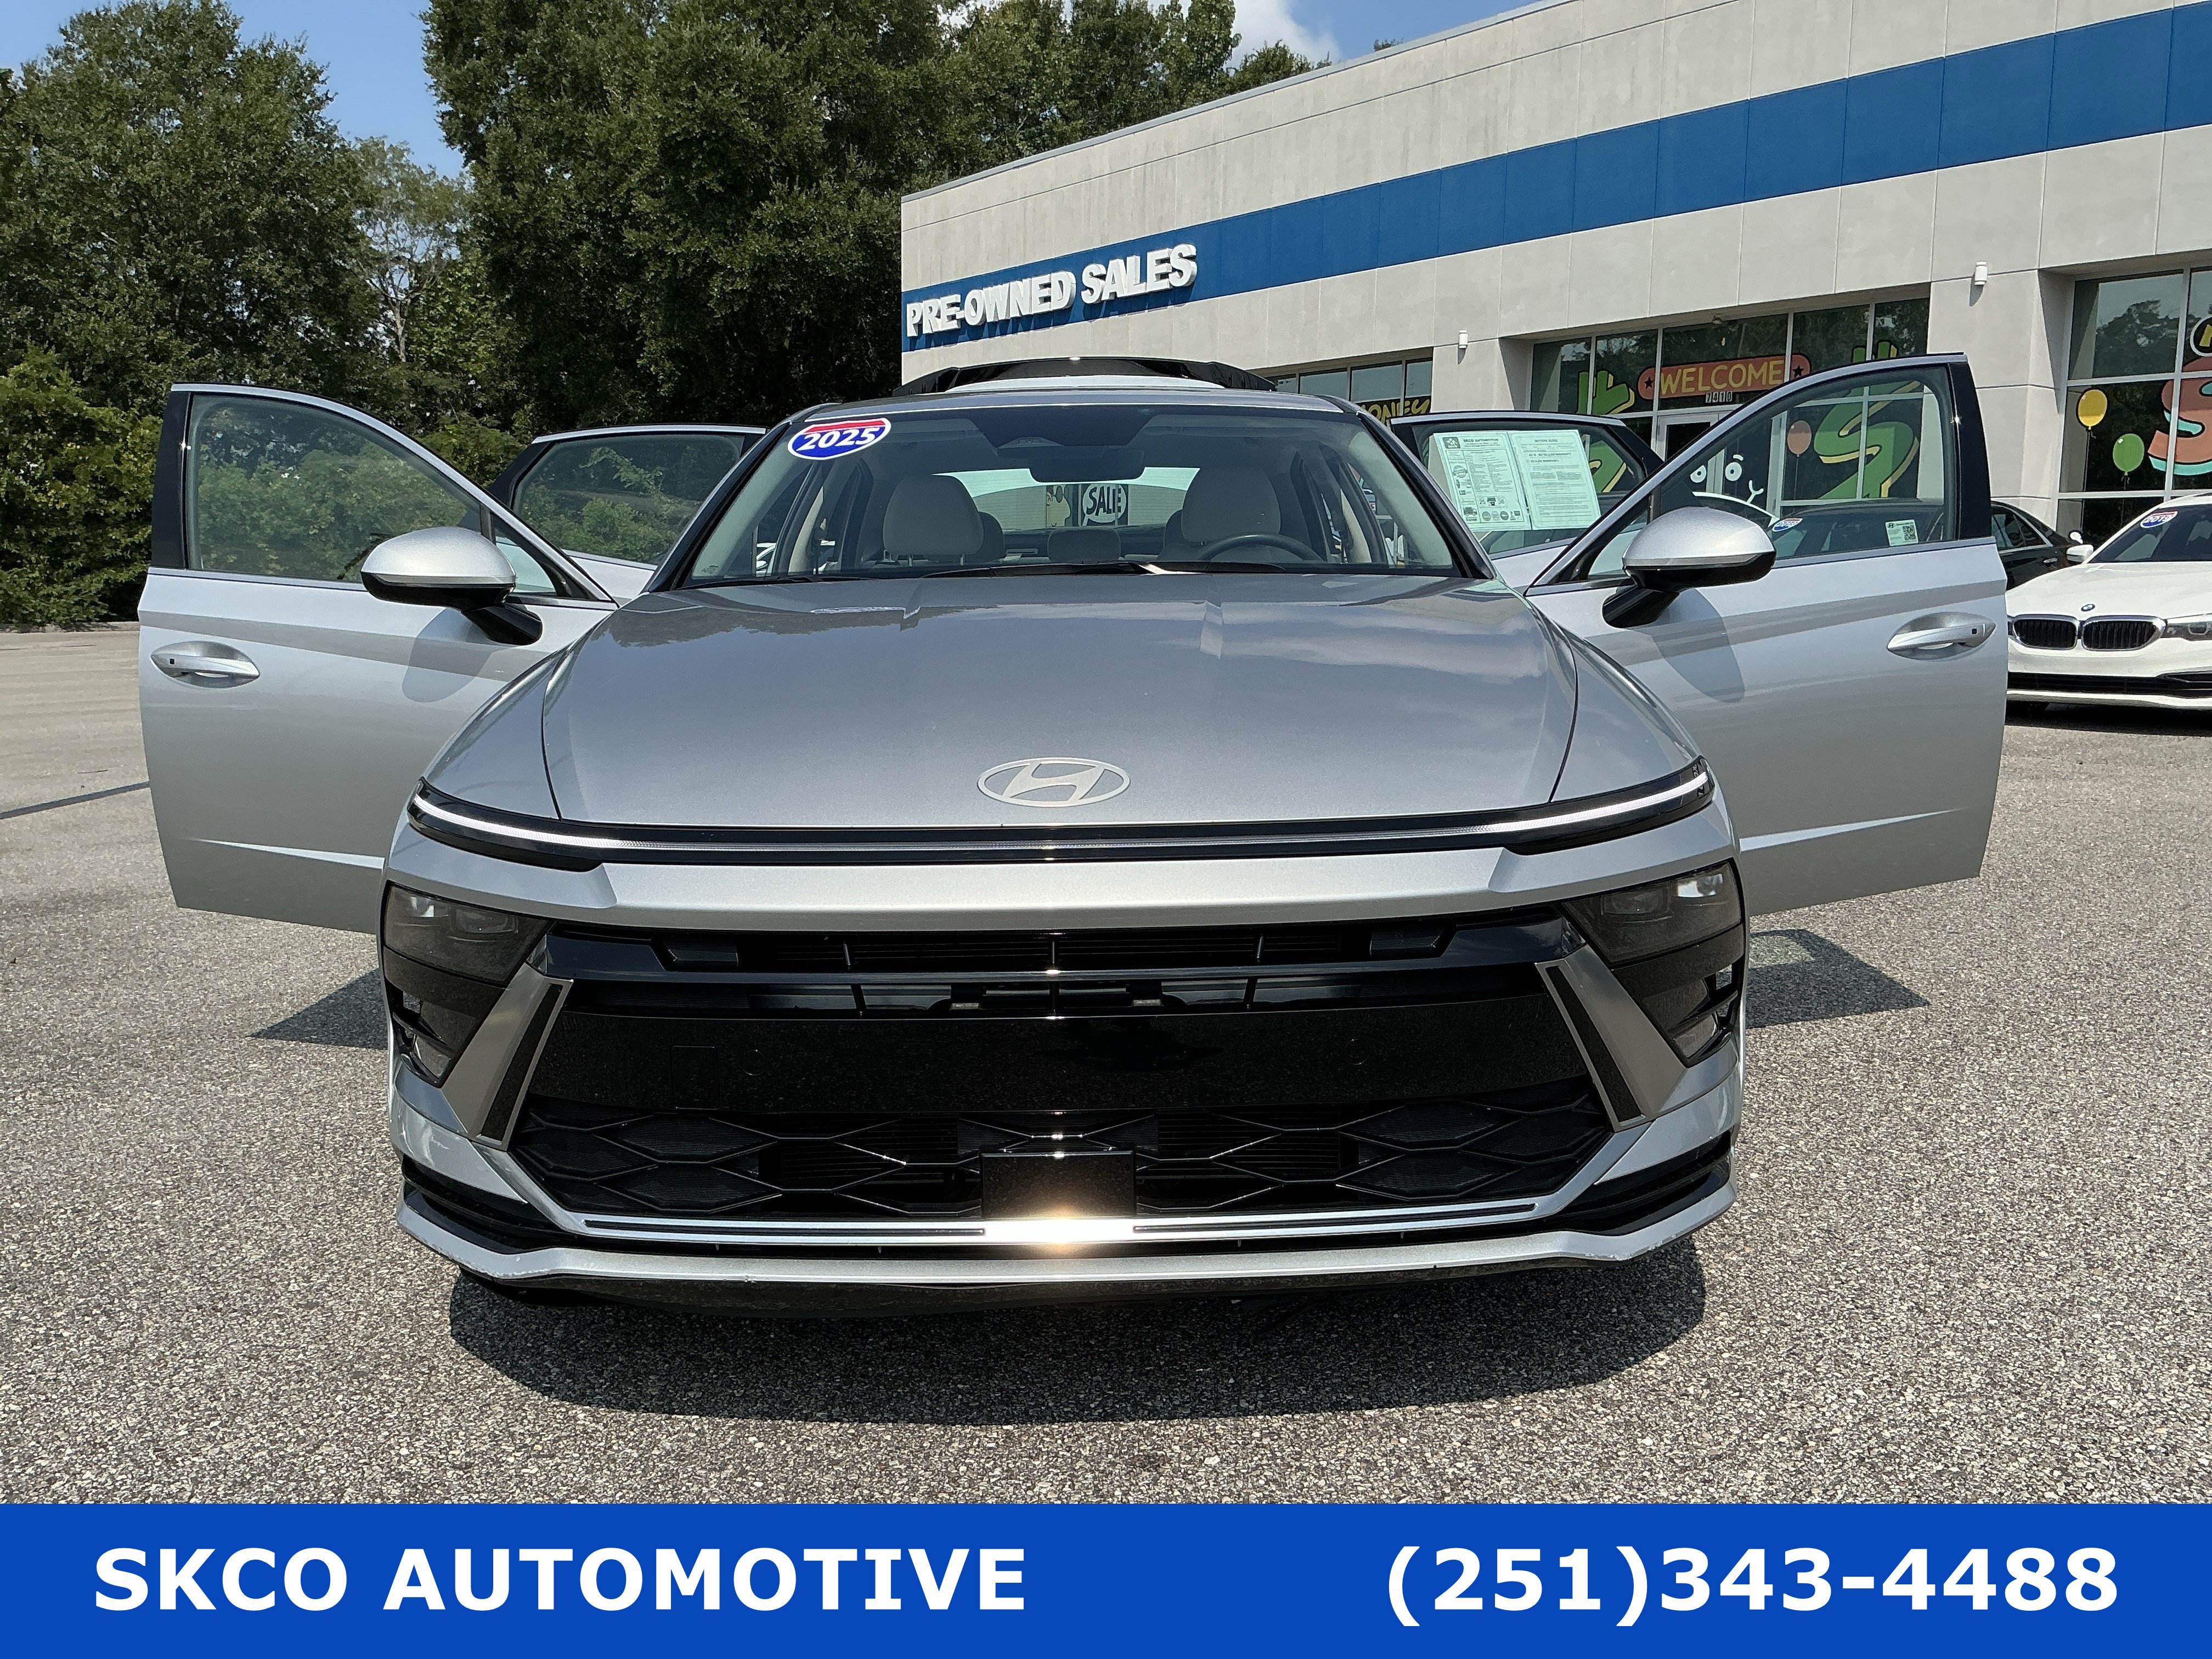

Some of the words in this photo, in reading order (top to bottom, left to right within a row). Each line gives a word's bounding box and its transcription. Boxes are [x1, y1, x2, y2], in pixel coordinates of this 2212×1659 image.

[906, 270, 1076, 337] PRE-OWNED
[1082, 243, 1197, 304] SALES
[1661, 359, 1785, 395] WELCOME
[1360, 398, 1431, 425] ONEY
[1705, 391, 1733, 403] 7410
[797, 426, 879, 452] 2025
[1086, 486, 1122, 517] SALE
